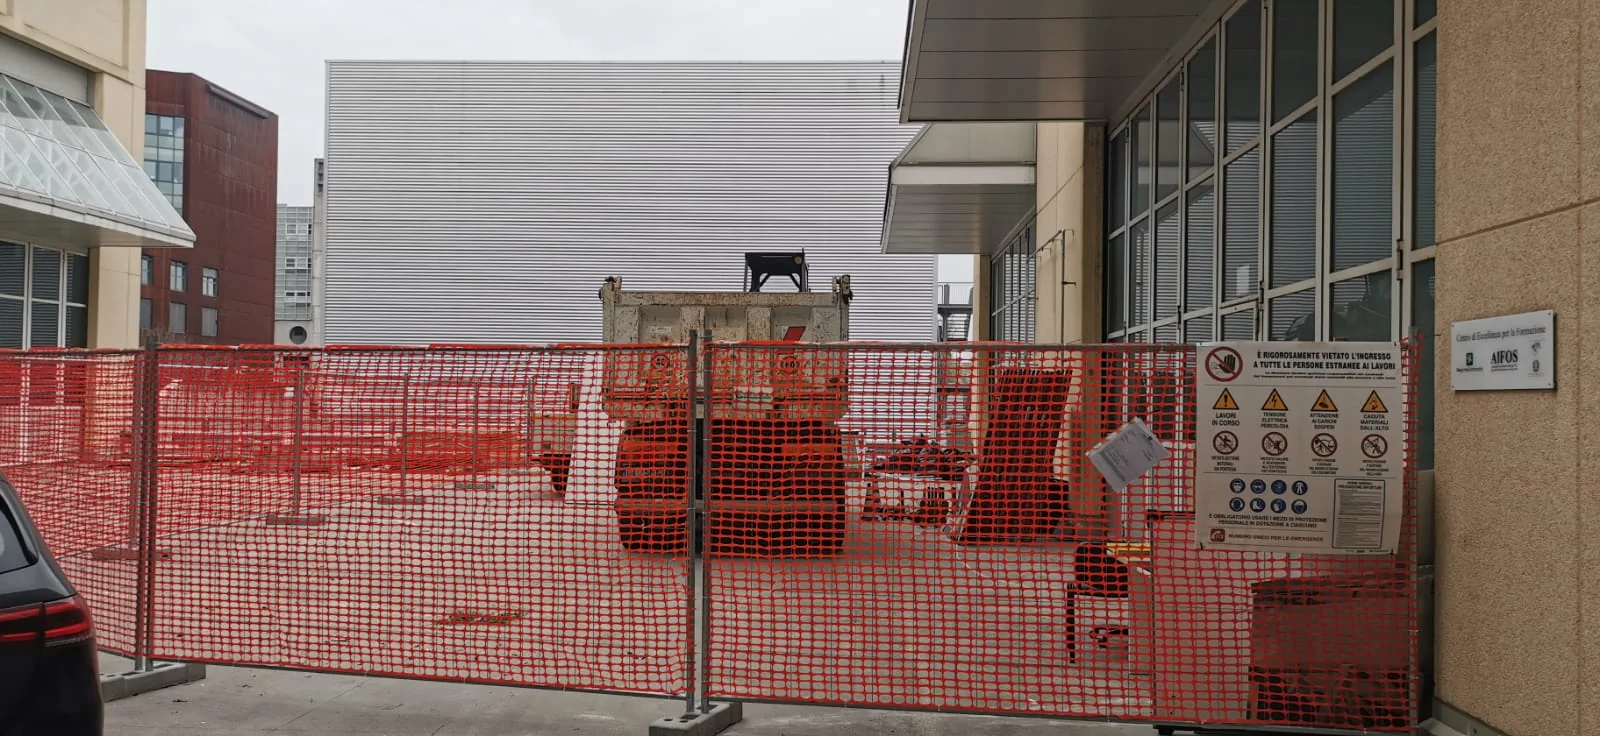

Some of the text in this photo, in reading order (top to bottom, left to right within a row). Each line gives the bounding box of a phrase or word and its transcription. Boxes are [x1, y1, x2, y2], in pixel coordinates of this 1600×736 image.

[1501, 329, 1510, 340] per
[1263, 351, 1320, 360] RIGOROSAMENTE
[1321, 352, 1350, 360] VIETATO
[1351, 352, 1392, 360] L'INGRESSO
[1490, 349, 1519, 364] AIFOS
[1260, 361, 1281, 369] TUTTE
[1293, 361, 1324, 369] PERSONE
[1326, 362, 1361, 370] ESTRANEE
[1371, 362, 1396, 370] LAVORI
